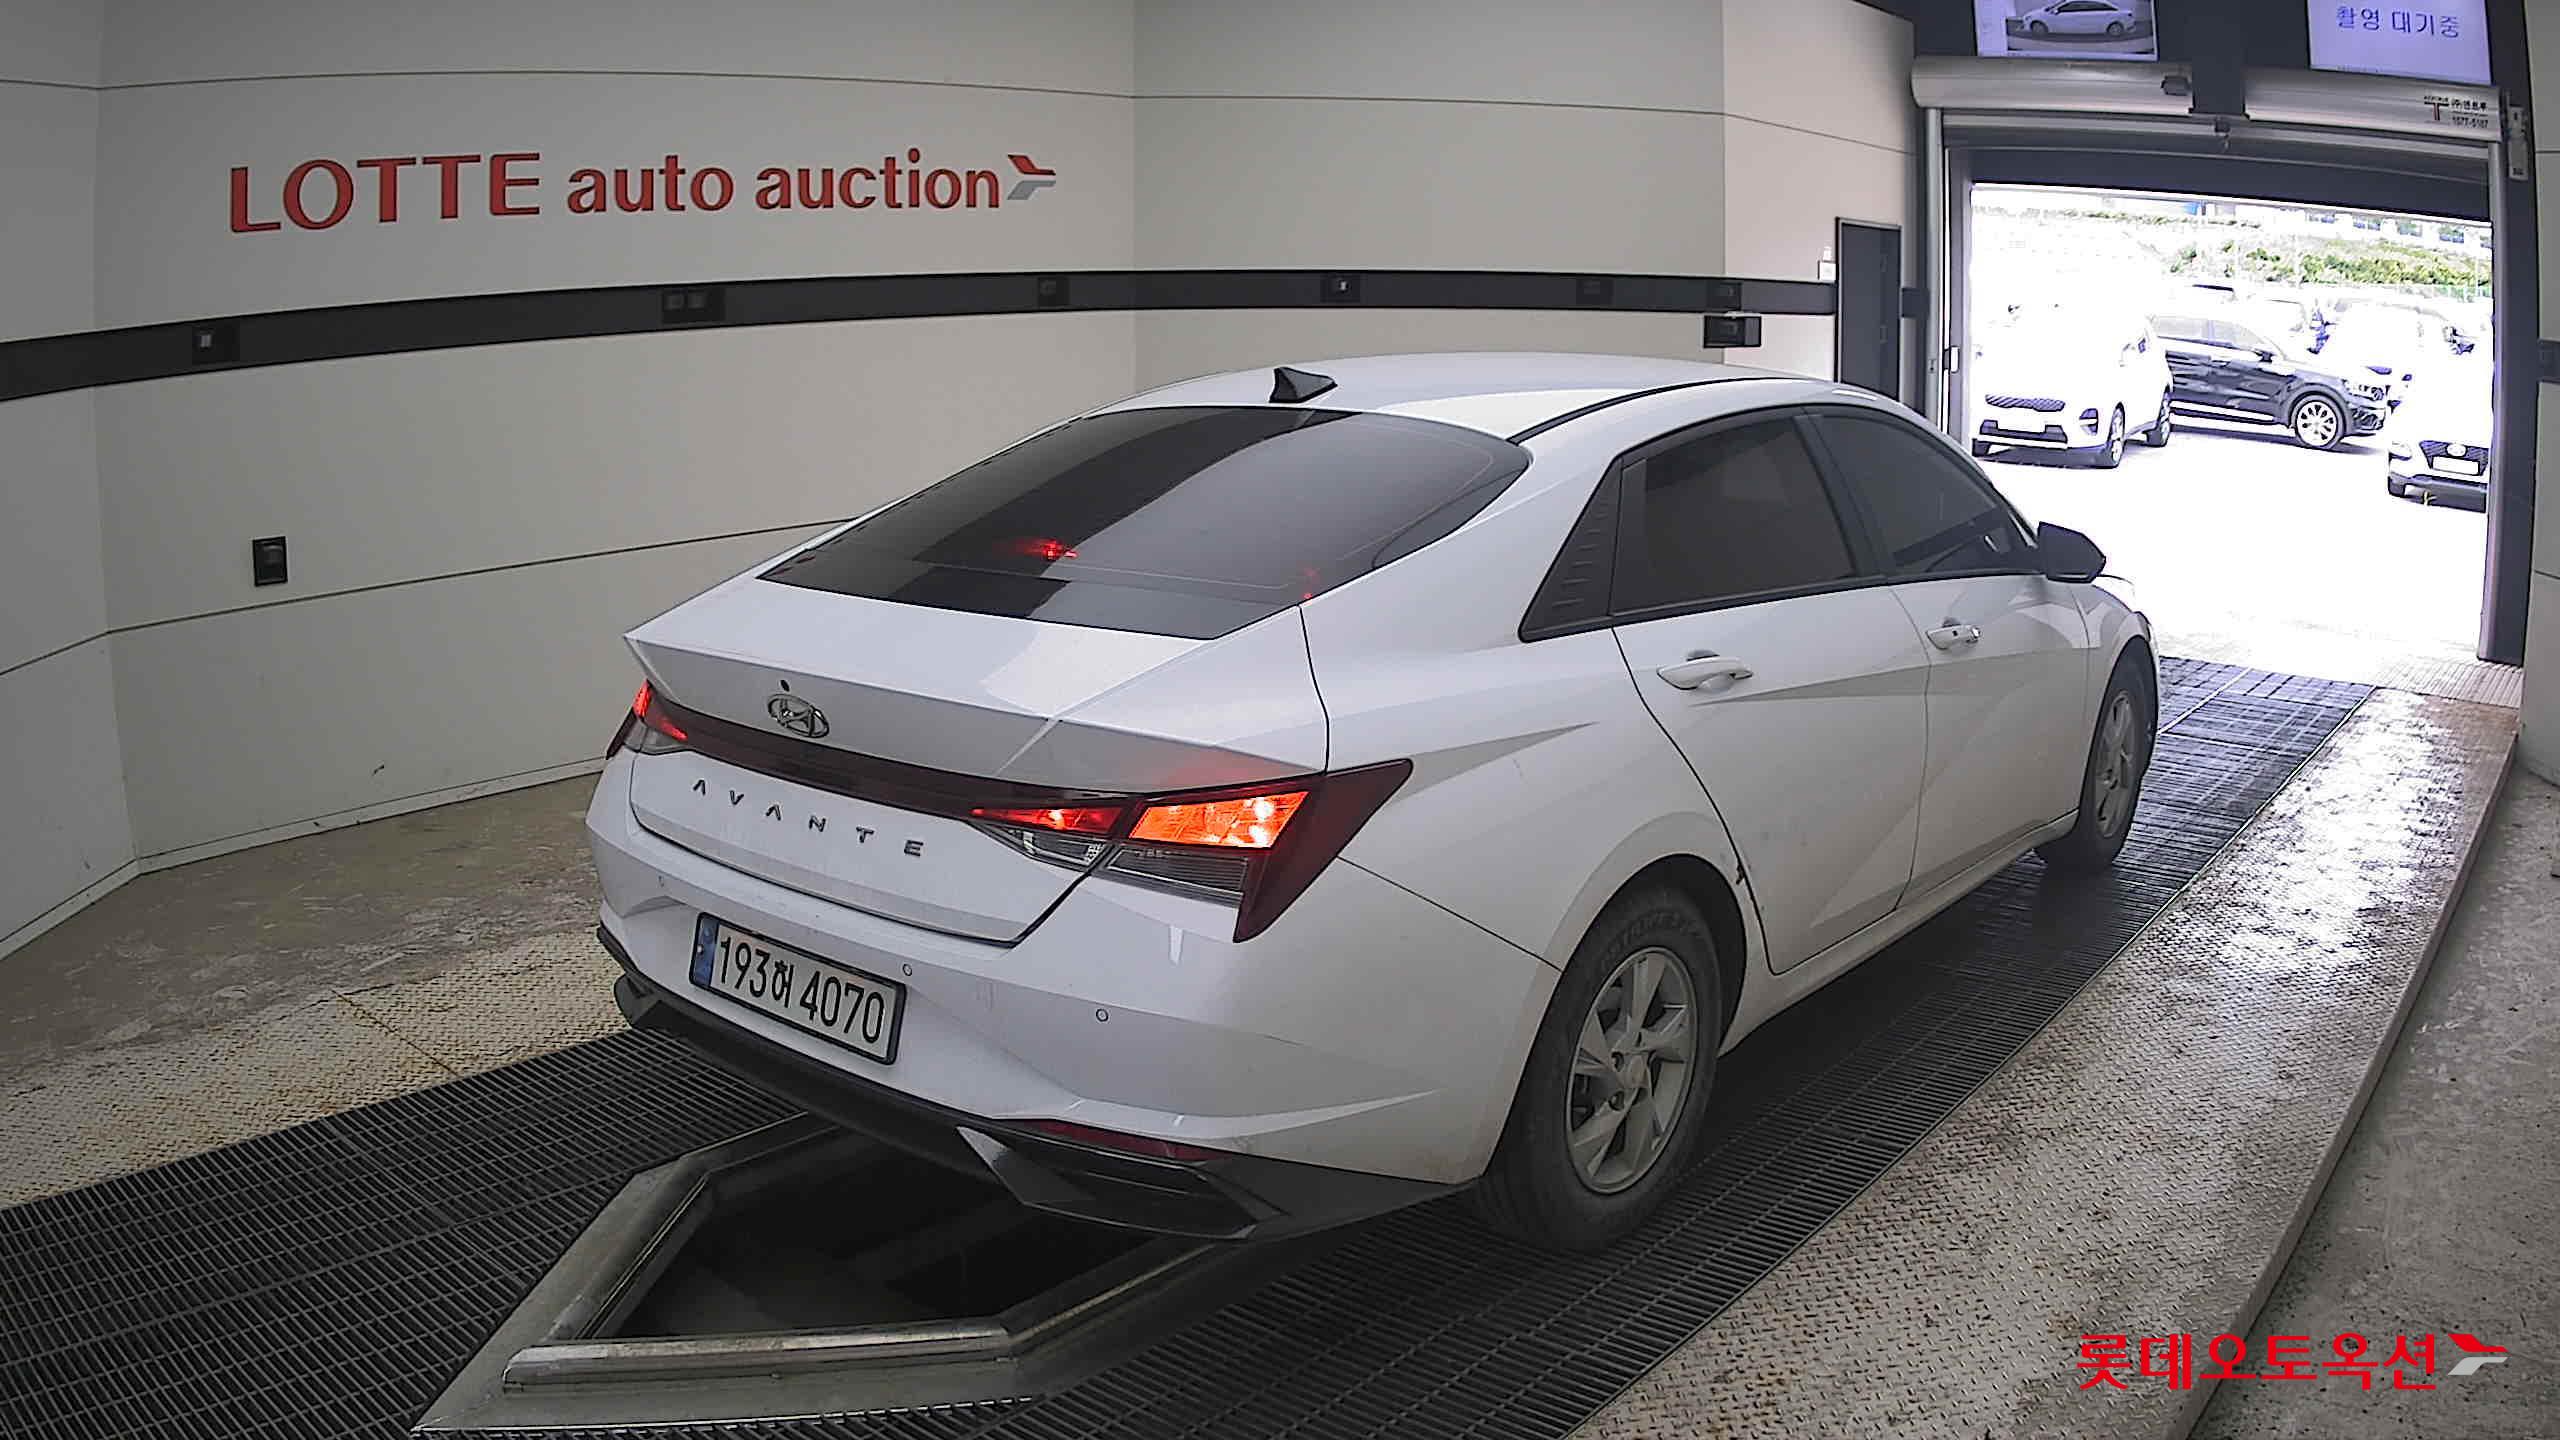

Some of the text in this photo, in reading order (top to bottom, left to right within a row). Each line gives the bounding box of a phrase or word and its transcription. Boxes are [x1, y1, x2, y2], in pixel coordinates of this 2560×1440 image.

[2336, 6, 2459, 39] 촬영 대기중
[229, 147, 1000, 233] LOTTE auto auction
[692, 778, 924, 858] AVANTE
[719, 936, 886, 1044] 193허 4070
